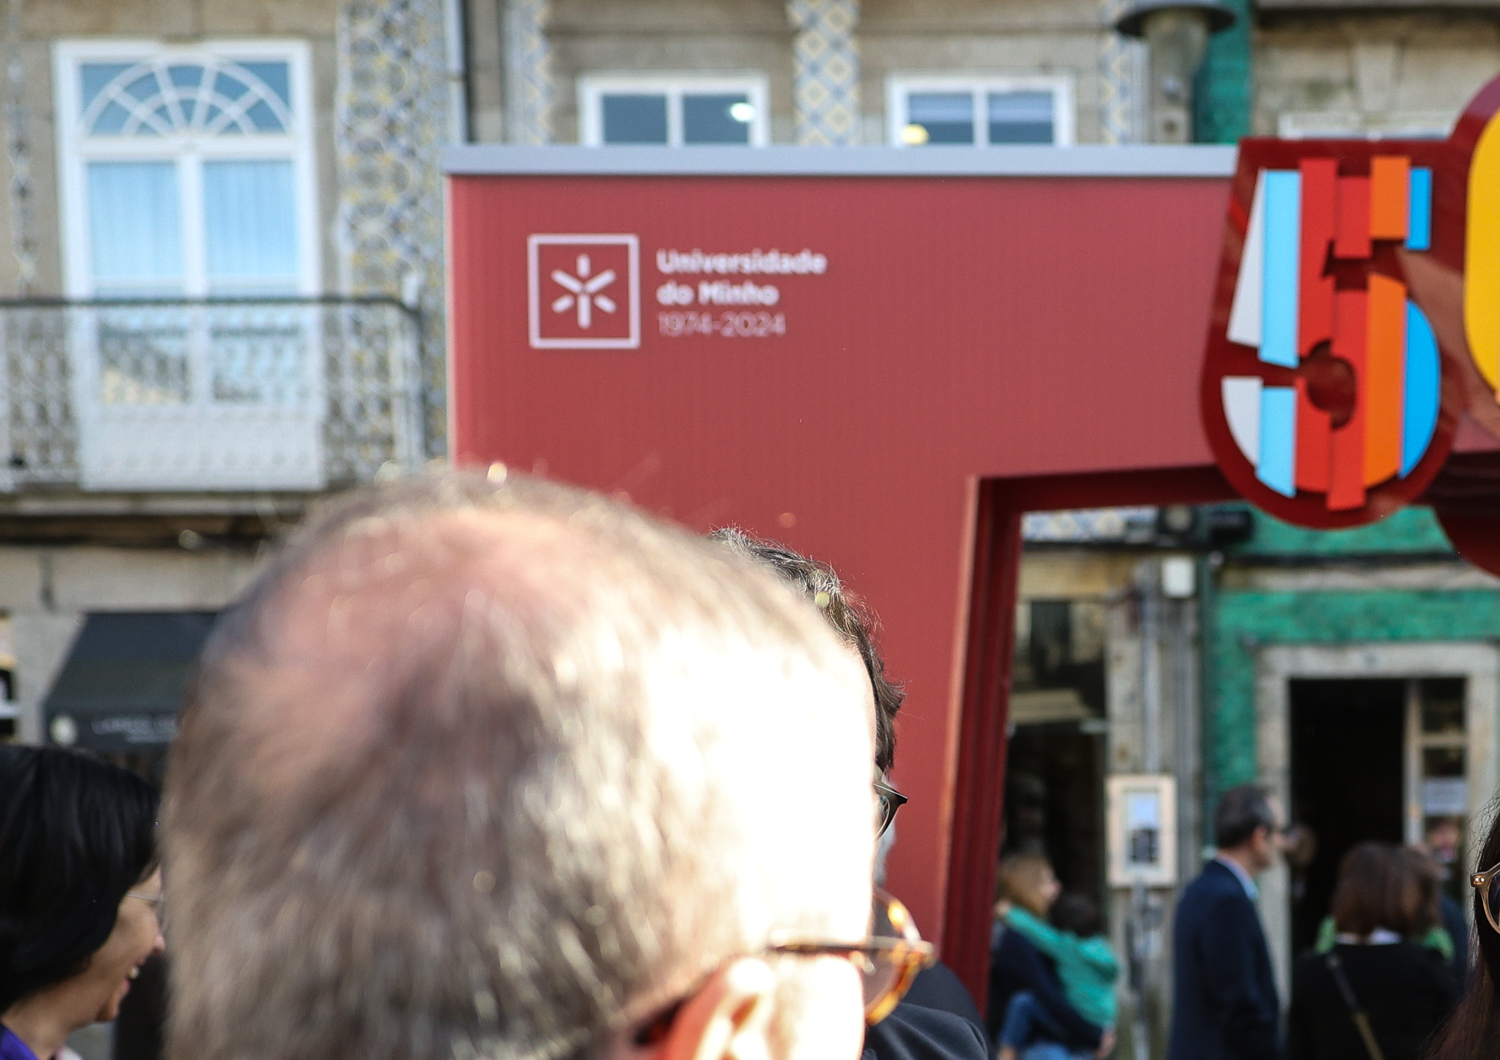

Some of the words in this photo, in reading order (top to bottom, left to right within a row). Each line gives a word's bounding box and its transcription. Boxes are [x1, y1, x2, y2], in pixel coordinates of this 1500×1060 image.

[656, 248, 828, 274] Universidade
[656, 281, 695, 305] do
[698, 280, 779, 306] Minho
[657, 311, 786, 337] 1974-2024
